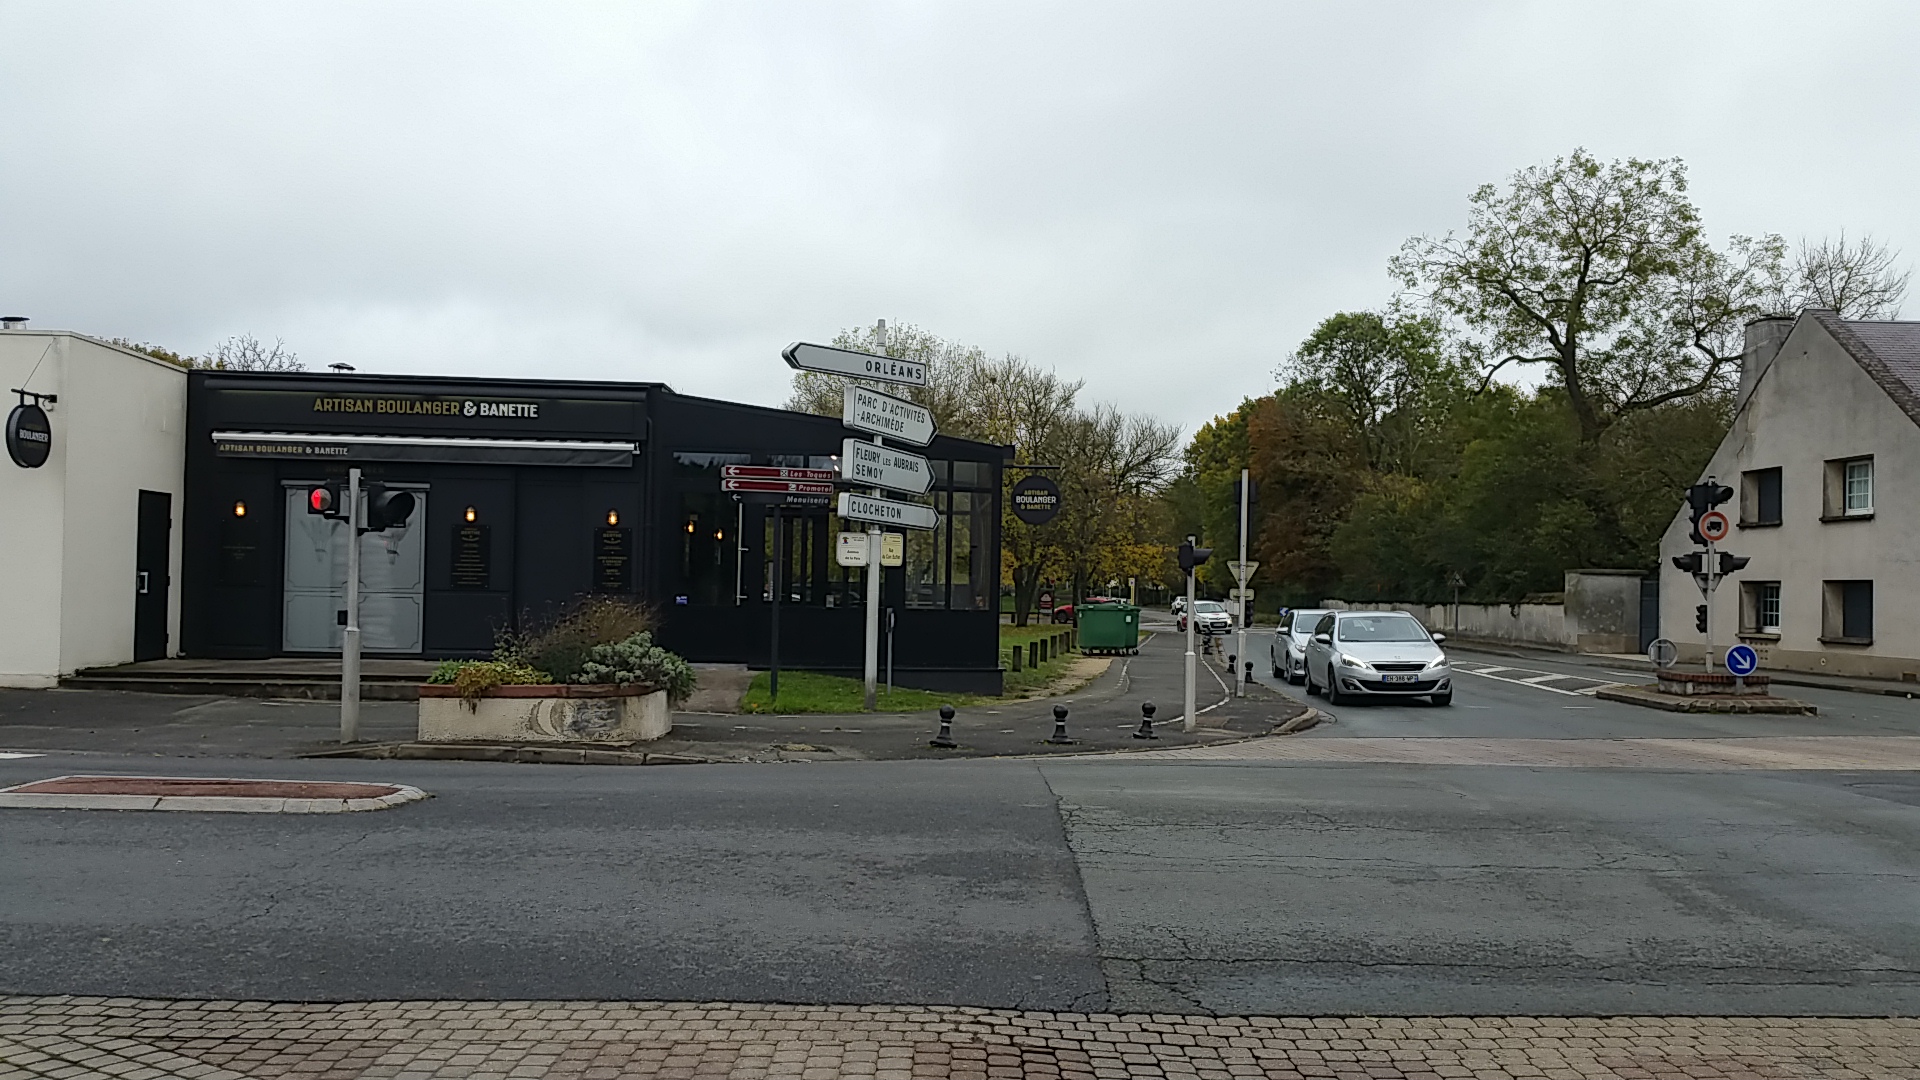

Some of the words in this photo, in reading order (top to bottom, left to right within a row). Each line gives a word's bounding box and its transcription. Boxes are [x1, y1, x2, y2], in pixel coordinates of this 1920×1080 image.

[865, 360, 922, 379] ORLÉANS
[313, 398, 373, 413] ARTISAN
[377, 400, 460, 415] BOULANGER
[463, 401, 477, 417] &
[480, 402, 539, 418] BANETTE
[857, 394, 878, 409] PARC
[881, 401, 926, 424] D'ACTIVITÉS
[19, 429, 48, 442] BOULANGER
[219, 444, 254, 452] ARTISAN
[256, 445, 303, 454] BOULANGER
[305, 446, 312, 454] &
[314, 447, 348, 455] BANETTE
[856, 447, 881, 464] FLEURY
[882, 457, 892, 467] LES
[893, 457, 919, 473] AUBRAIS
[855, 464, 884, 480] SEMOY
[786, 496, 829, 504] Menuiserie
[1015, 496, 1057, 504] BOULANGER
[851, 501, 902, 519] CLOCHETON
